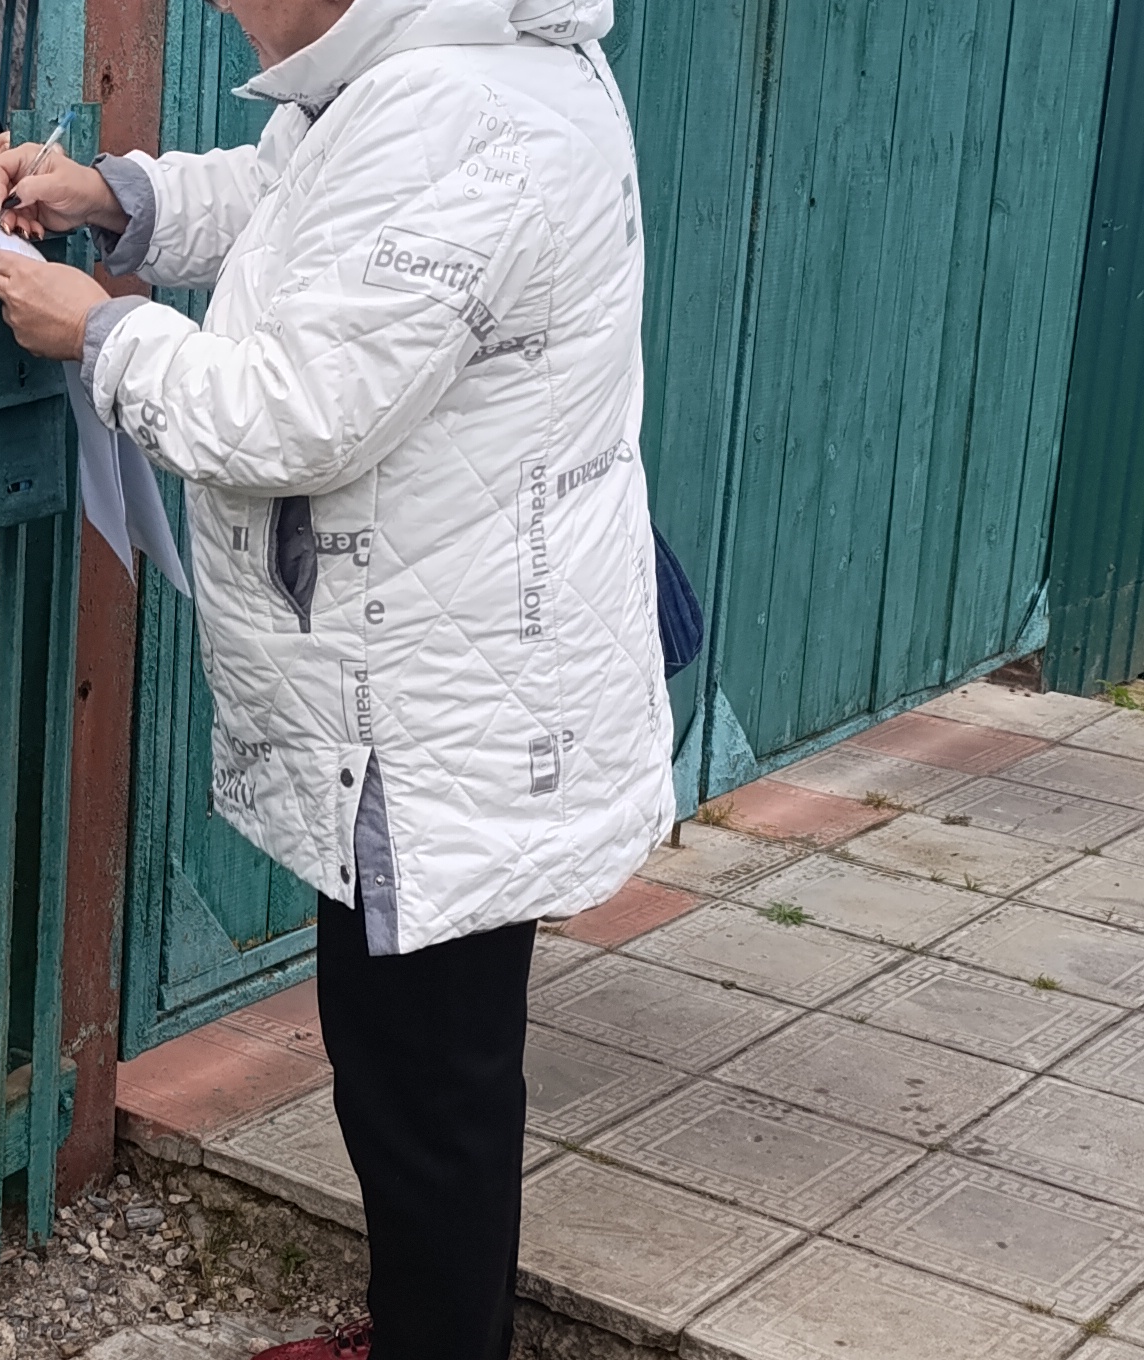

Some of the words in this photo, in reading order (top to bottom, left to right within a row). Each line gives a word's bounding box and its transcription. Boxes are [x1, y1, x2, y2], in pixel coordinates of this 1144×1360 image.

[468, 135, 487, 154] TO
[458, 159, 479, 177] TO
[484, 166, 514, 186] THE
[523, 584, 543, 637] love
